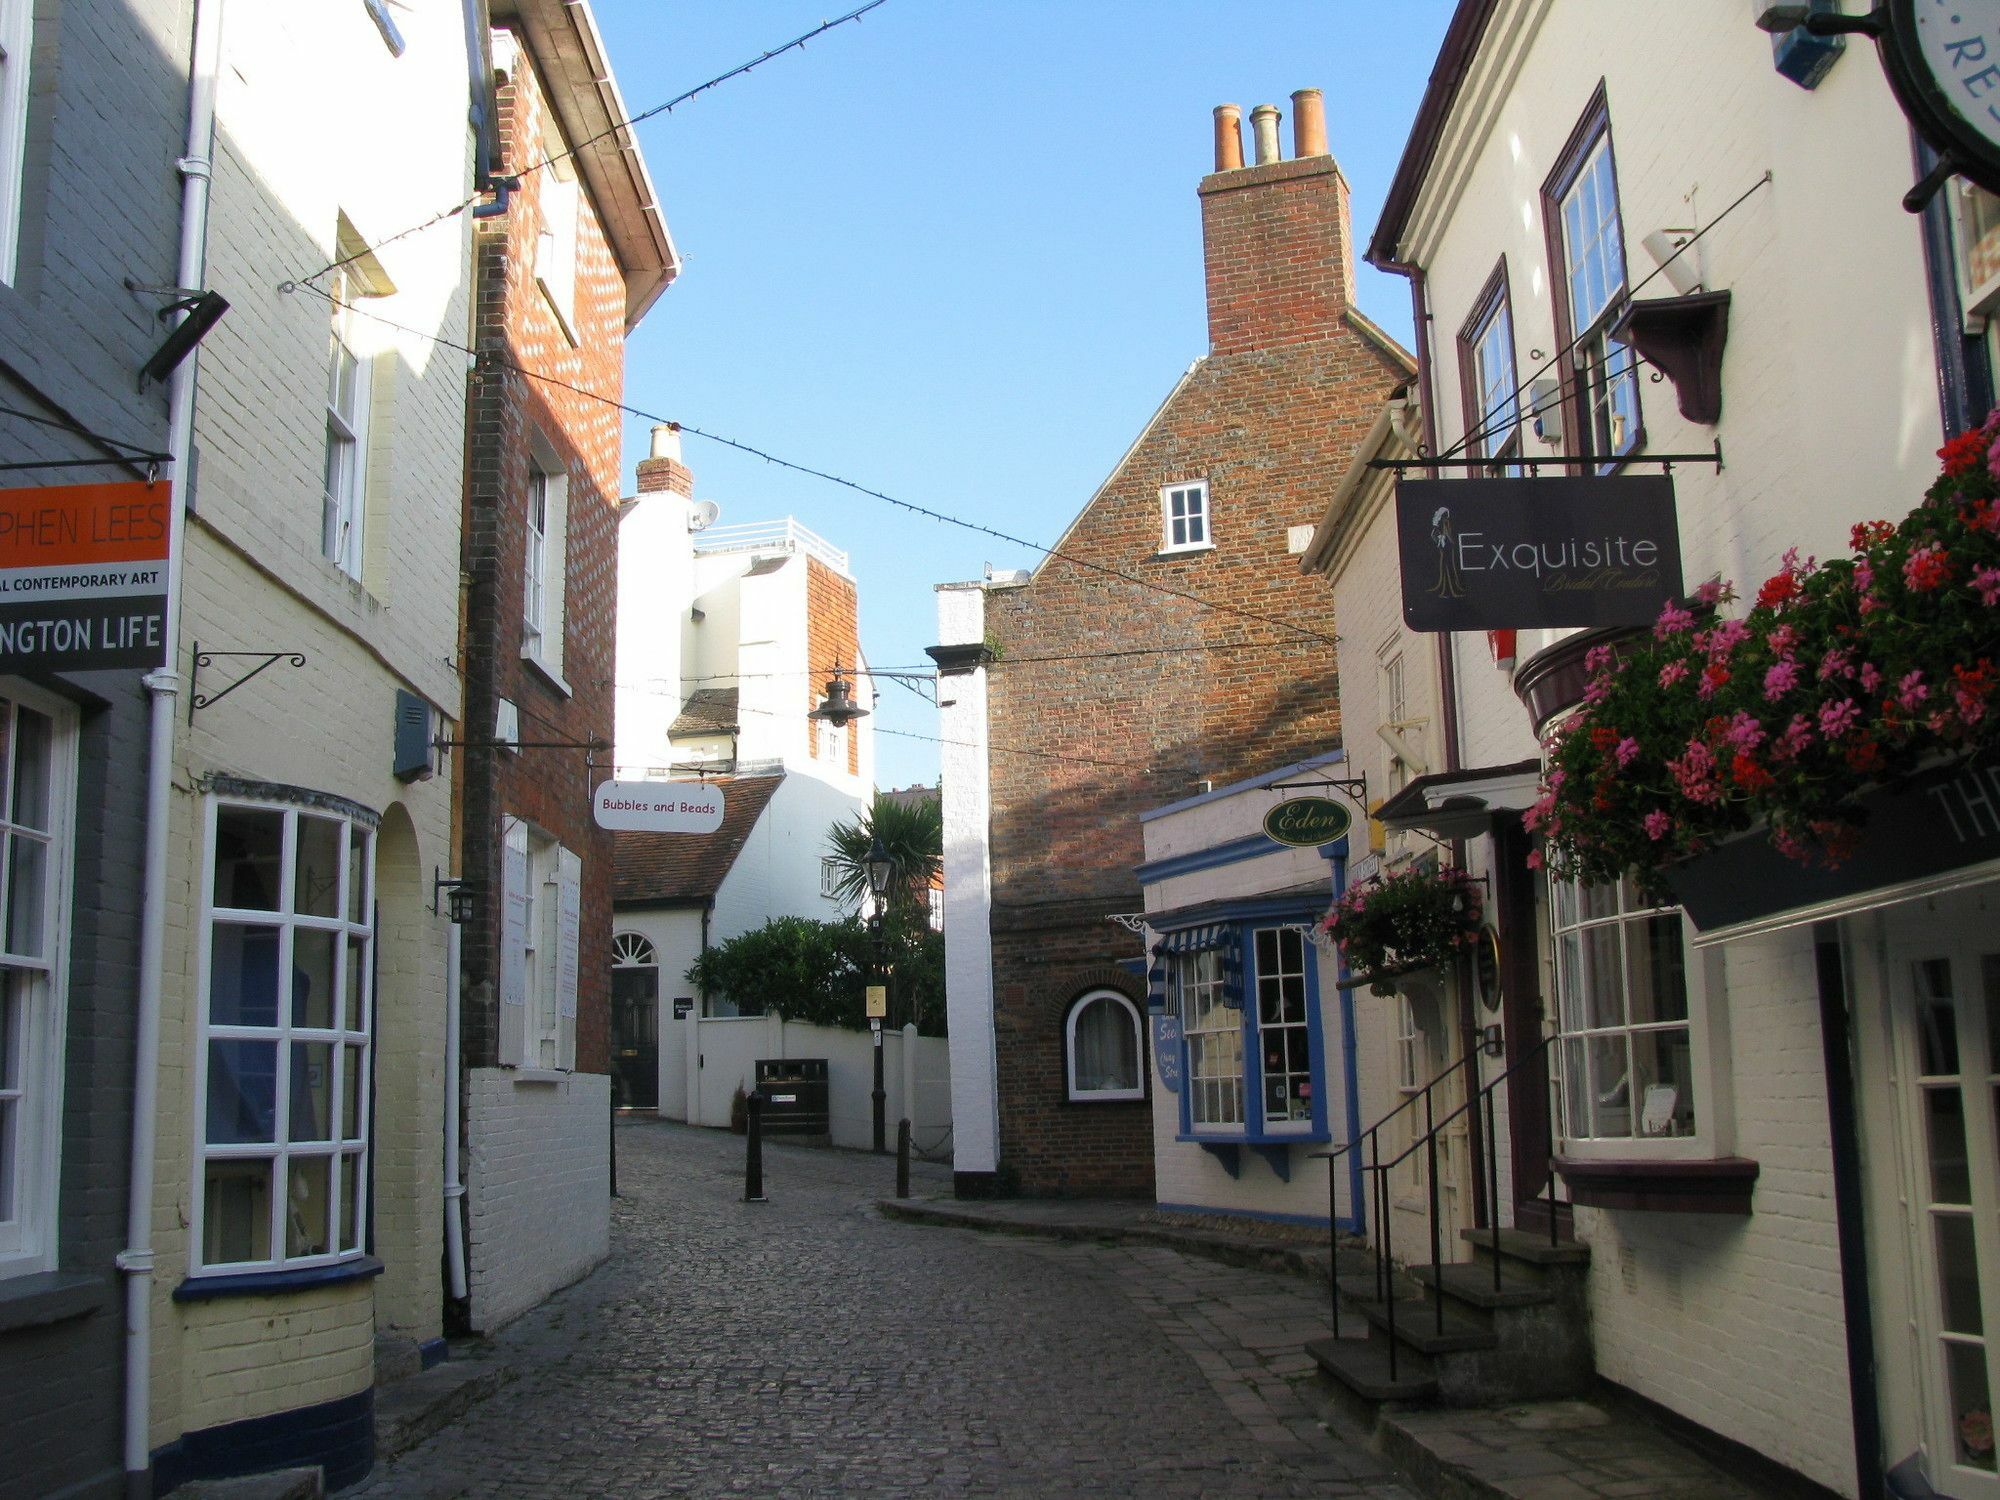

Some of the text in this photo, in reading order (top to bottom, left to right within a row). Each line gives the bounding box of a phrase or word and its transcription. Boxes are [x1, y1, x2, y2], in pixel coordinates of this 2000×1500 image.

[93, 503, 165, 542] LEES
[1457, 532, 1658, 578] Exquisite
[14, 573, 127, 591] CONTEMPORARY
[131, 571, 159, 585] ART
[102, 615, 161, 649] LIFE
[602, 799, 715, 814] Bubbles and Beads
[1279, 803, 1336, 830] Eden
